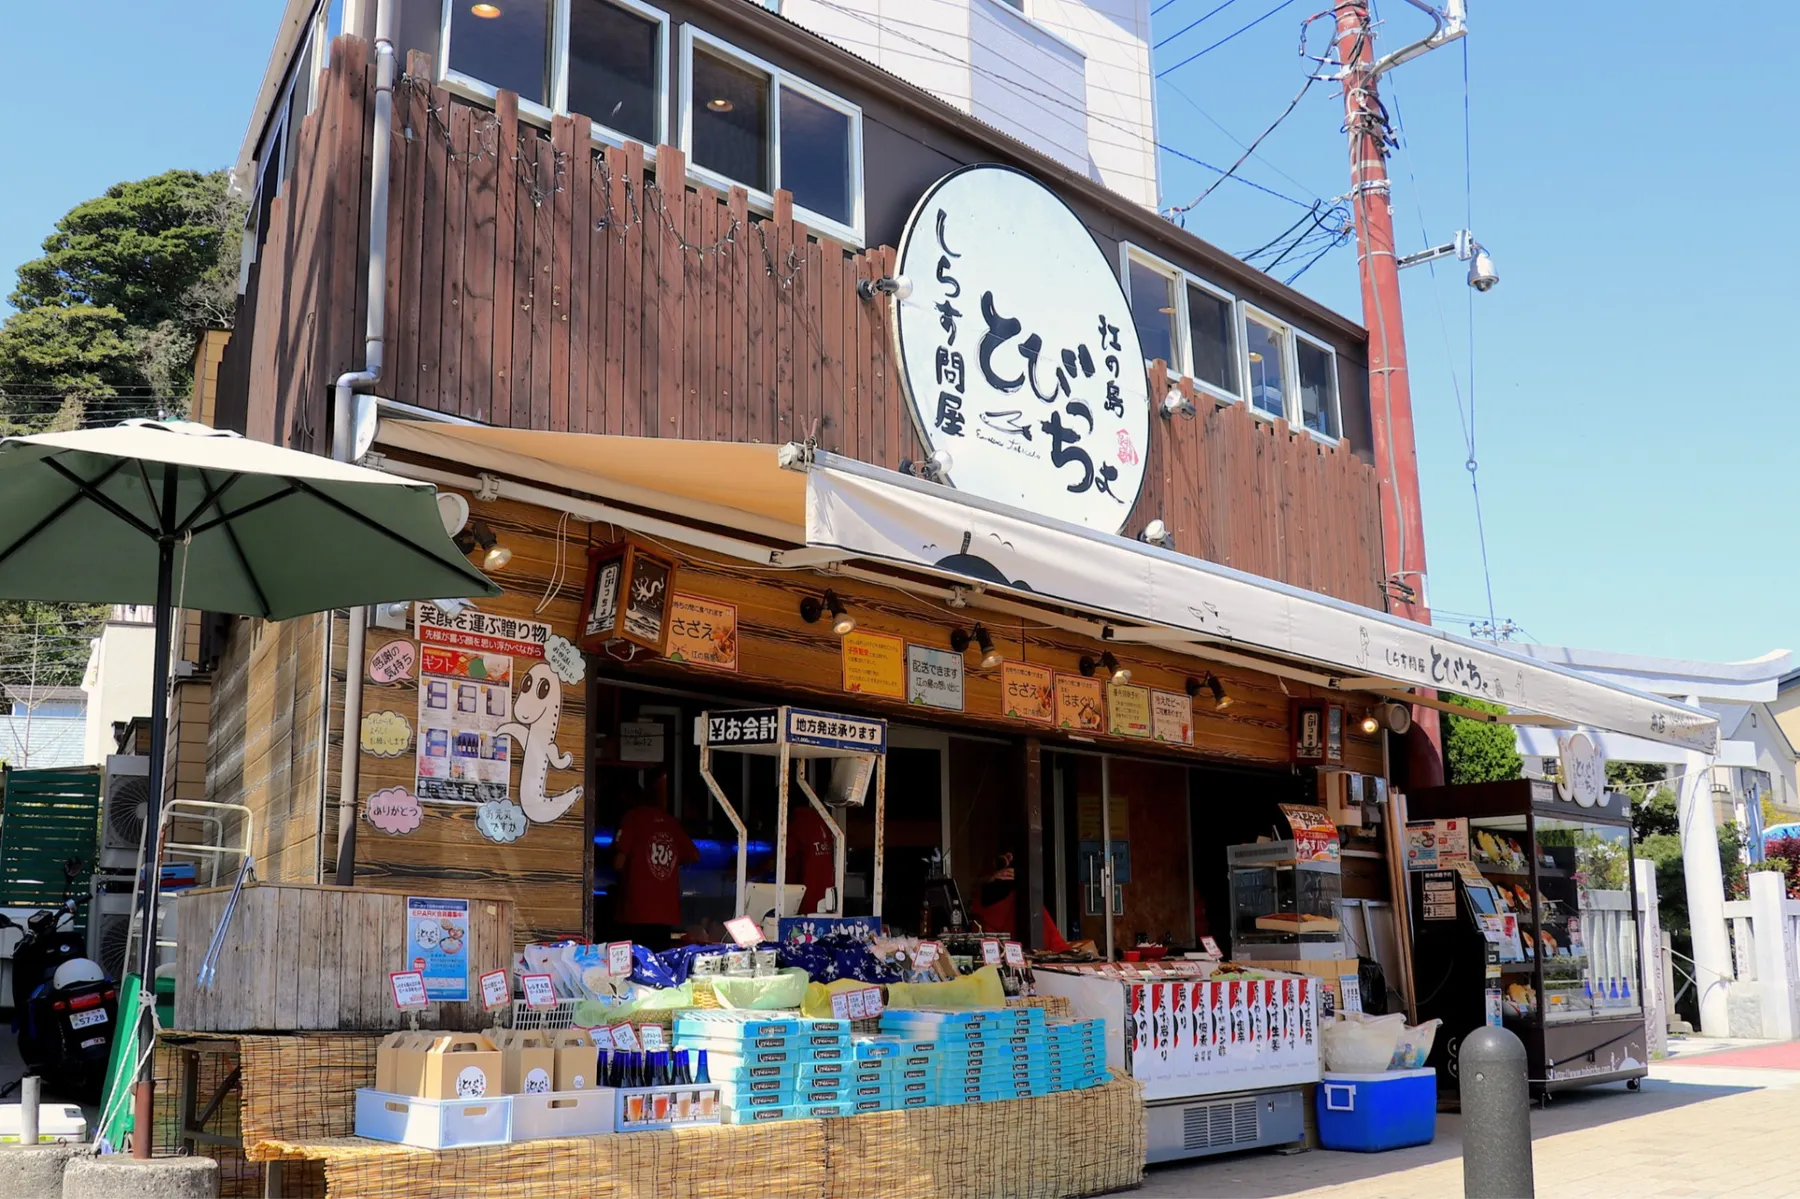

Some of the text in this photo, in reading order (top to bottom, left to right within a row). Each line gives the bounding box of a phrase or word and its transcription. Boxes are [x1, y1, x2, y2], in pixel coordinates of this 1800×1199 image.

[935, 208, 965, 437] しらす問屋
[1098, 314, 1124, 418] 江の島
[976, 290, 1125, 504] とびっちょ
[672, 617, 714, 641] さざえ
[372, 645, 400, 672] 感謝の
[383, 654, 413, 680] 気持ち
[423, 654, 454, 672] ギフト
[912, 659, 958, 679] 配送できます
[1386, 648, 1425, 673] しらす問屋
[1008, 681, 1038, 699] さざえ
[1062, 693, 1095, 709] はまぐり
[726, 715, 777, 741] お会計
[796, 717, 877, 741] 地方発送承ります
